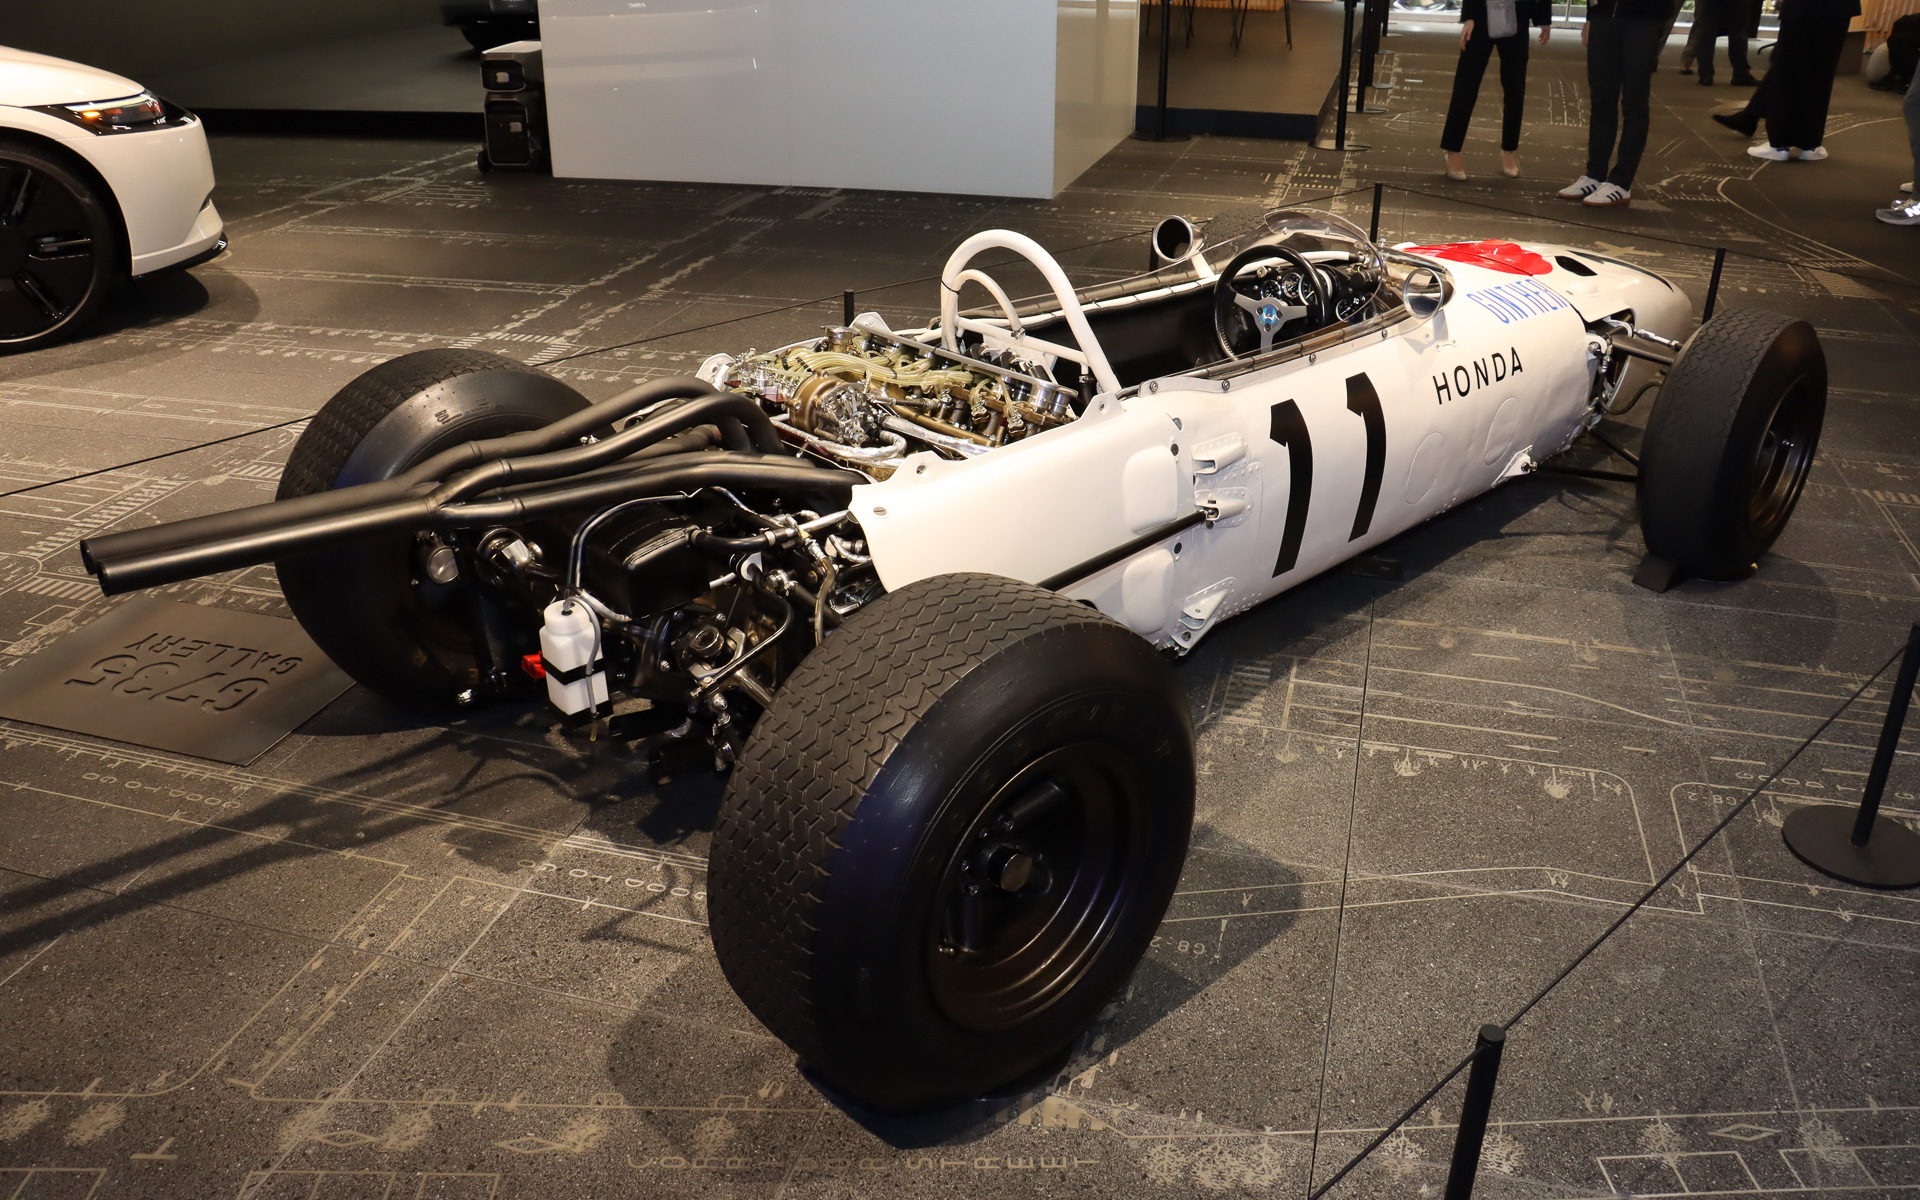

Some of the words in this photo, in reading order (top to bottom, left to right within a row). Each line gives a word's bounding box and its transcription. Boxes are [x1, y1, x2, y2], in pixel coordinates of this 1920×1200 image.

[1466, 279, 1568, 324] GINTHER
[1432, 346, 1523, 405] HONDA
[1269, 371, 1387, 579] 11
[123, 633, 303, 675] GALLERY
[64, 654, 270, 712] G735
[907, 1156, 1101, 1170] STREET
